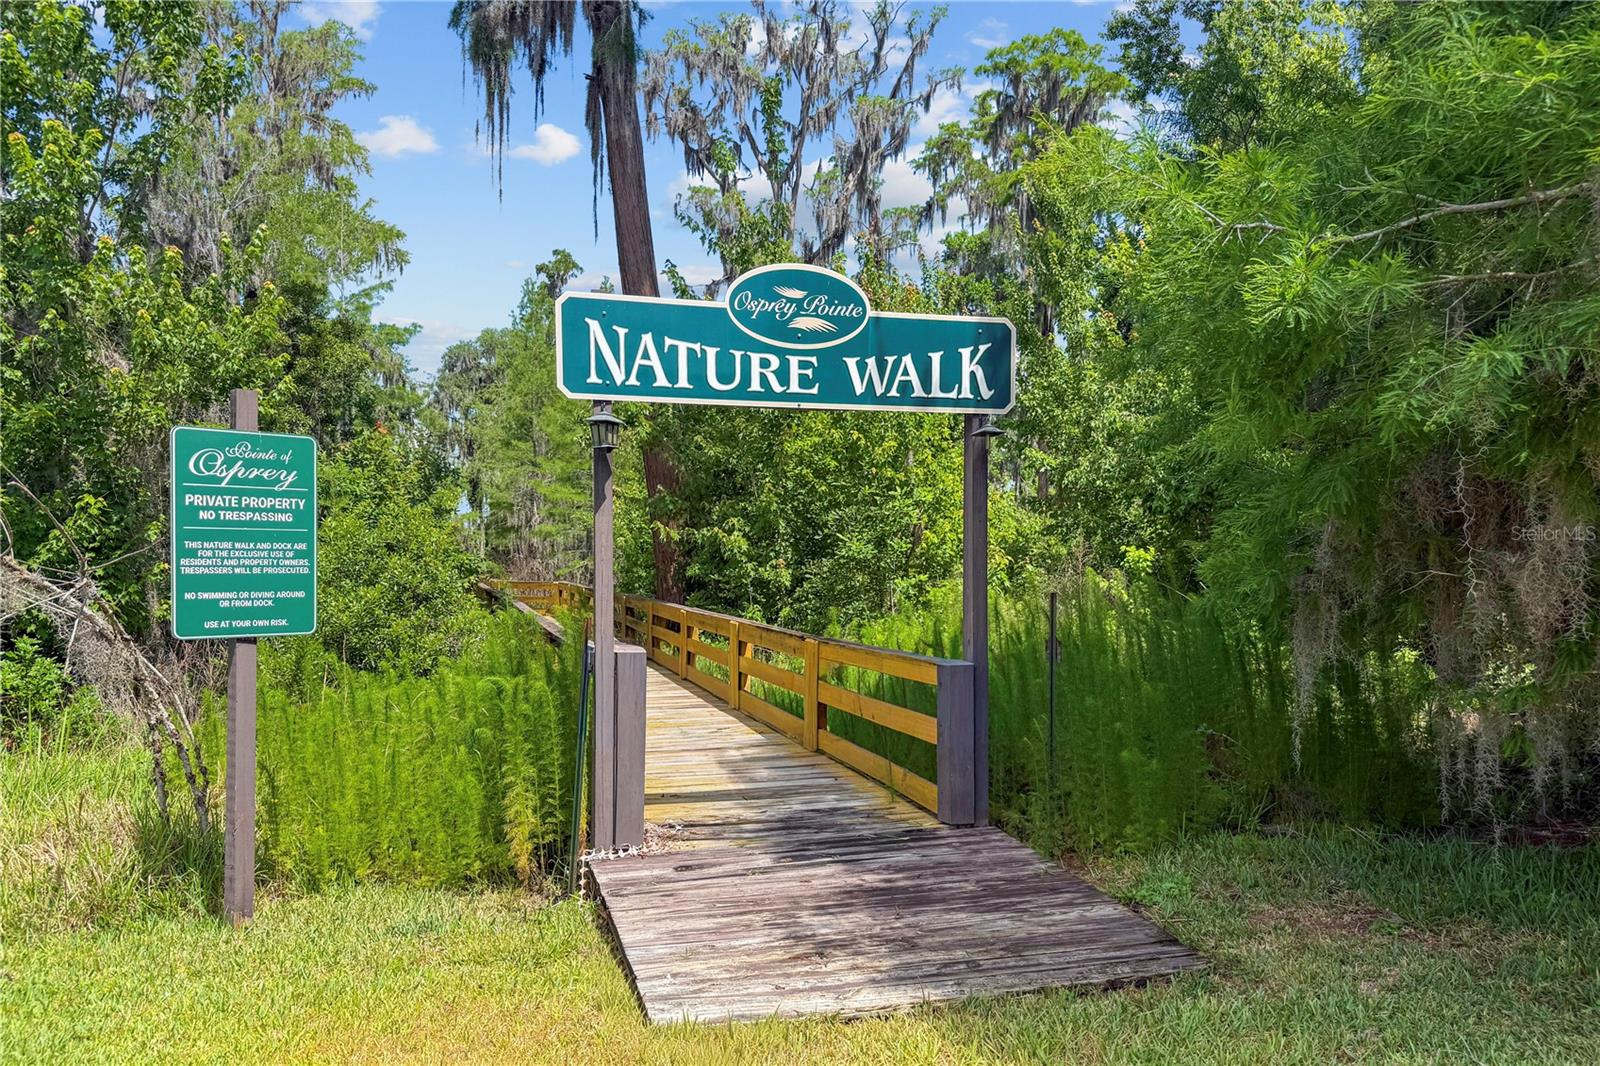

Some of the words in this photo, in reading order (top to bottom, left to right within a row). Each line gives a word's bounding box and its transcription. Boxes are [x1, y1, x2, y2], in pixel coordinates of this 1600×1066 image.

[733, 291, 799, 319] Osprey
[799, 294, 863, 318] Pointe
[584, 317, 820, 394] NATURE
[842, 343, 995, 400] WALK
[226, 441, 277, 460] Pointe
[281, 450, 292, 464] of
[189, 448, 297, 491] Osprey
[185, 494, 238, 507] PRIVATE
[242, 497, 305, 509] PROPERTY
[199, 511, 215, 519] NO
[218, 511, 293, 521] TRESPASSING
[204, 541, 233, 549] NATURE
